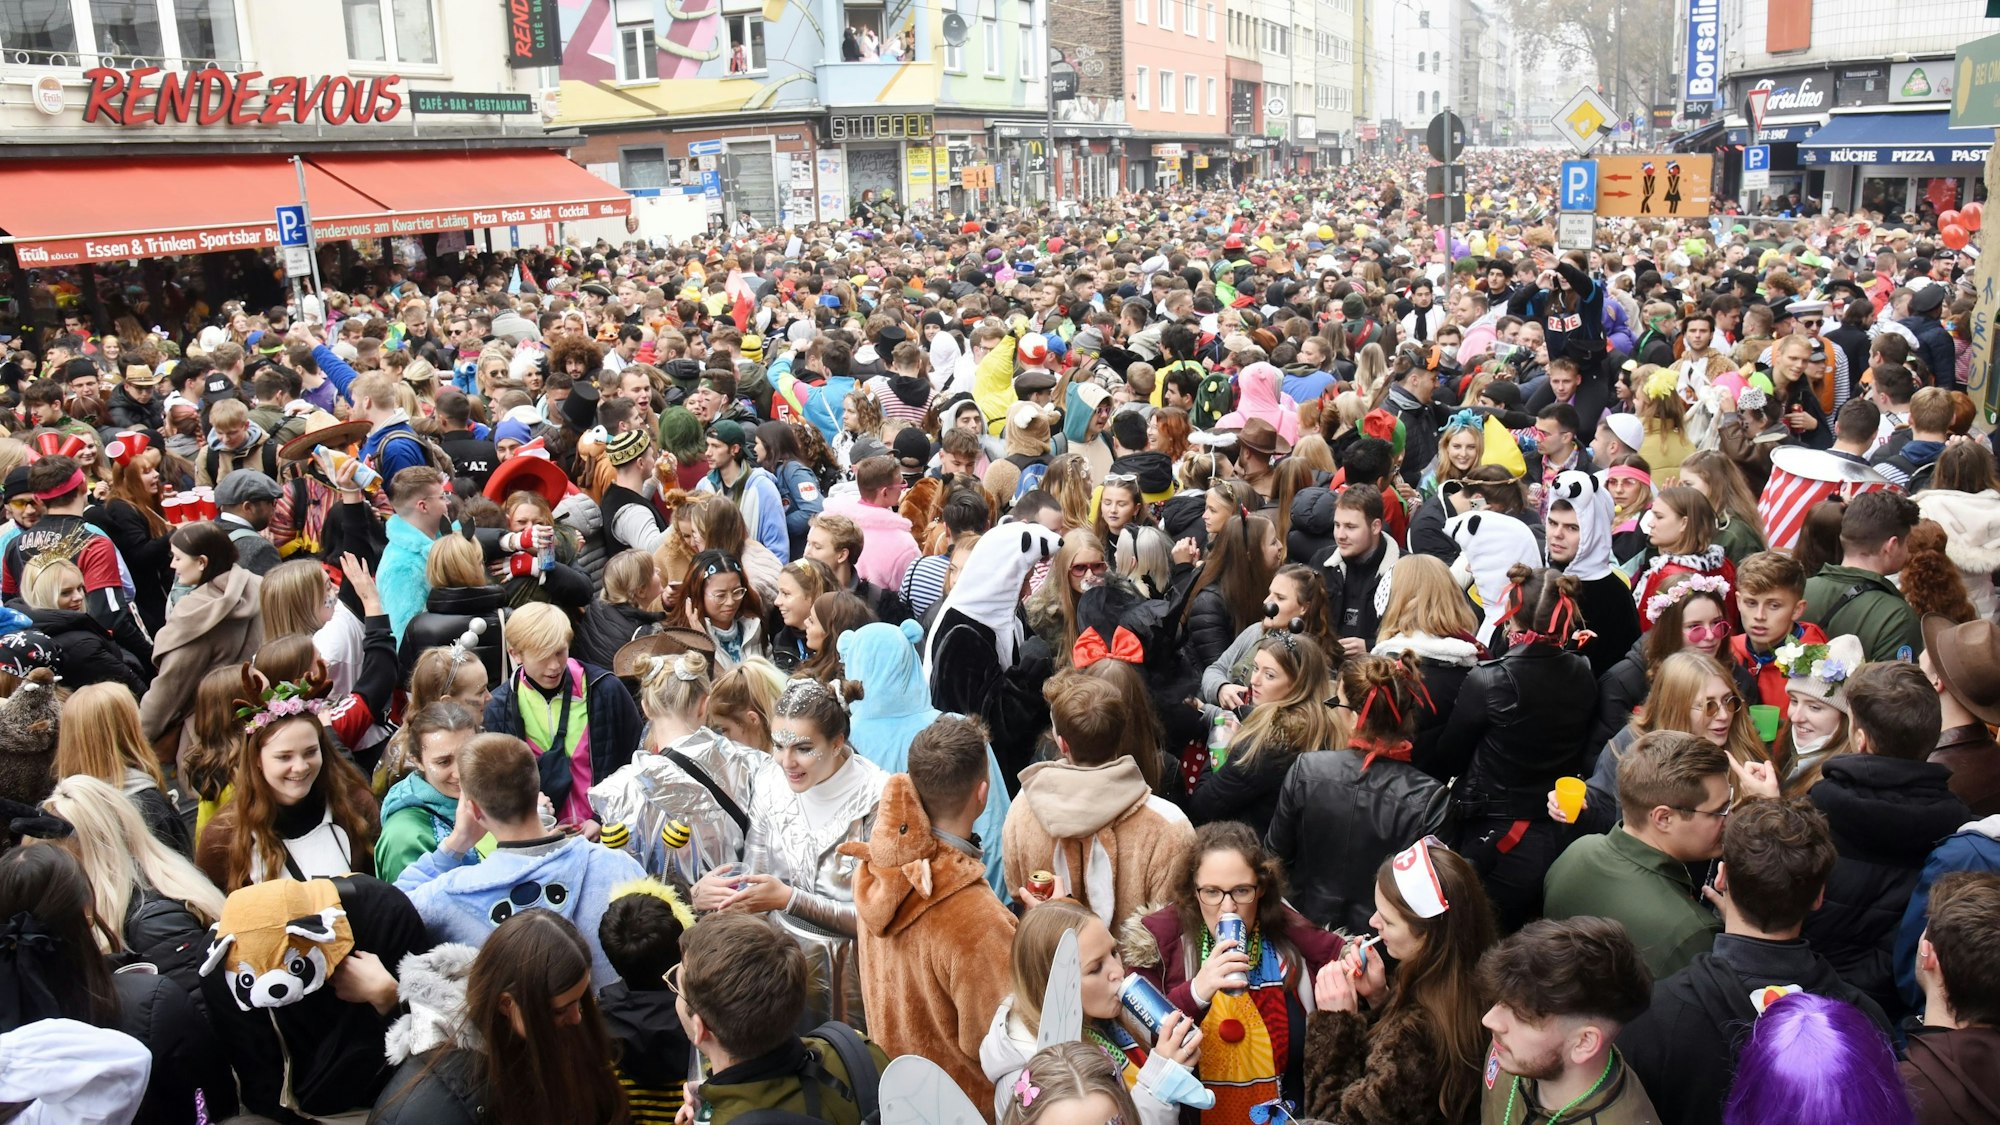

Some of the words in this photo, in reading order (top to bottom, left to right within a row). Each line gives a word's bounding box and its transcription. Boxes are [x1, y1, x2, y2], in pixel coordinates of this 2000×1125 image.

[534, 22, 545, 48] CAFÉ
[83, 65, 402, 126] RENDEZVOUS
[419, 95, 443, 110] CAFÉ
[450, 98, 467, 111] BAR
[474, 99, 528, 111] RESTAURANT
[1686, 103, 1708, 114] sky
[832, 116, 932, 138] STIEFEL
[1749, 149, 1763, 168] P
[1830, 149, 1878, 162] KÜCHE
[1891, 150, 1935, 162] PIZZA
[1568, 167, 1588, 204] P
[280, 210, 297, 242] P
[313, 225, 371, 239] endezvous
[374, 222, 390, 234] am
[392, 217, 434, 232] Kwartier
[437, 213, 468, 229] Latäng
[473, 211, 497, 225] Pizza
[502, 209, 526, 223] Pasta
[530, 207, 552, 220] Salat
[558, 204, 590, 218] Cocktail
[51, 252, 79, 260] KÖLSCH
[86, 240, 127, 259] Essen
[131, 239, 143, 255] &
[148, 233, 196, 252] Trinken
[199, 229, 261, 250] Sportsbar
[1125, 992, 1155, 1028] ENERGY
